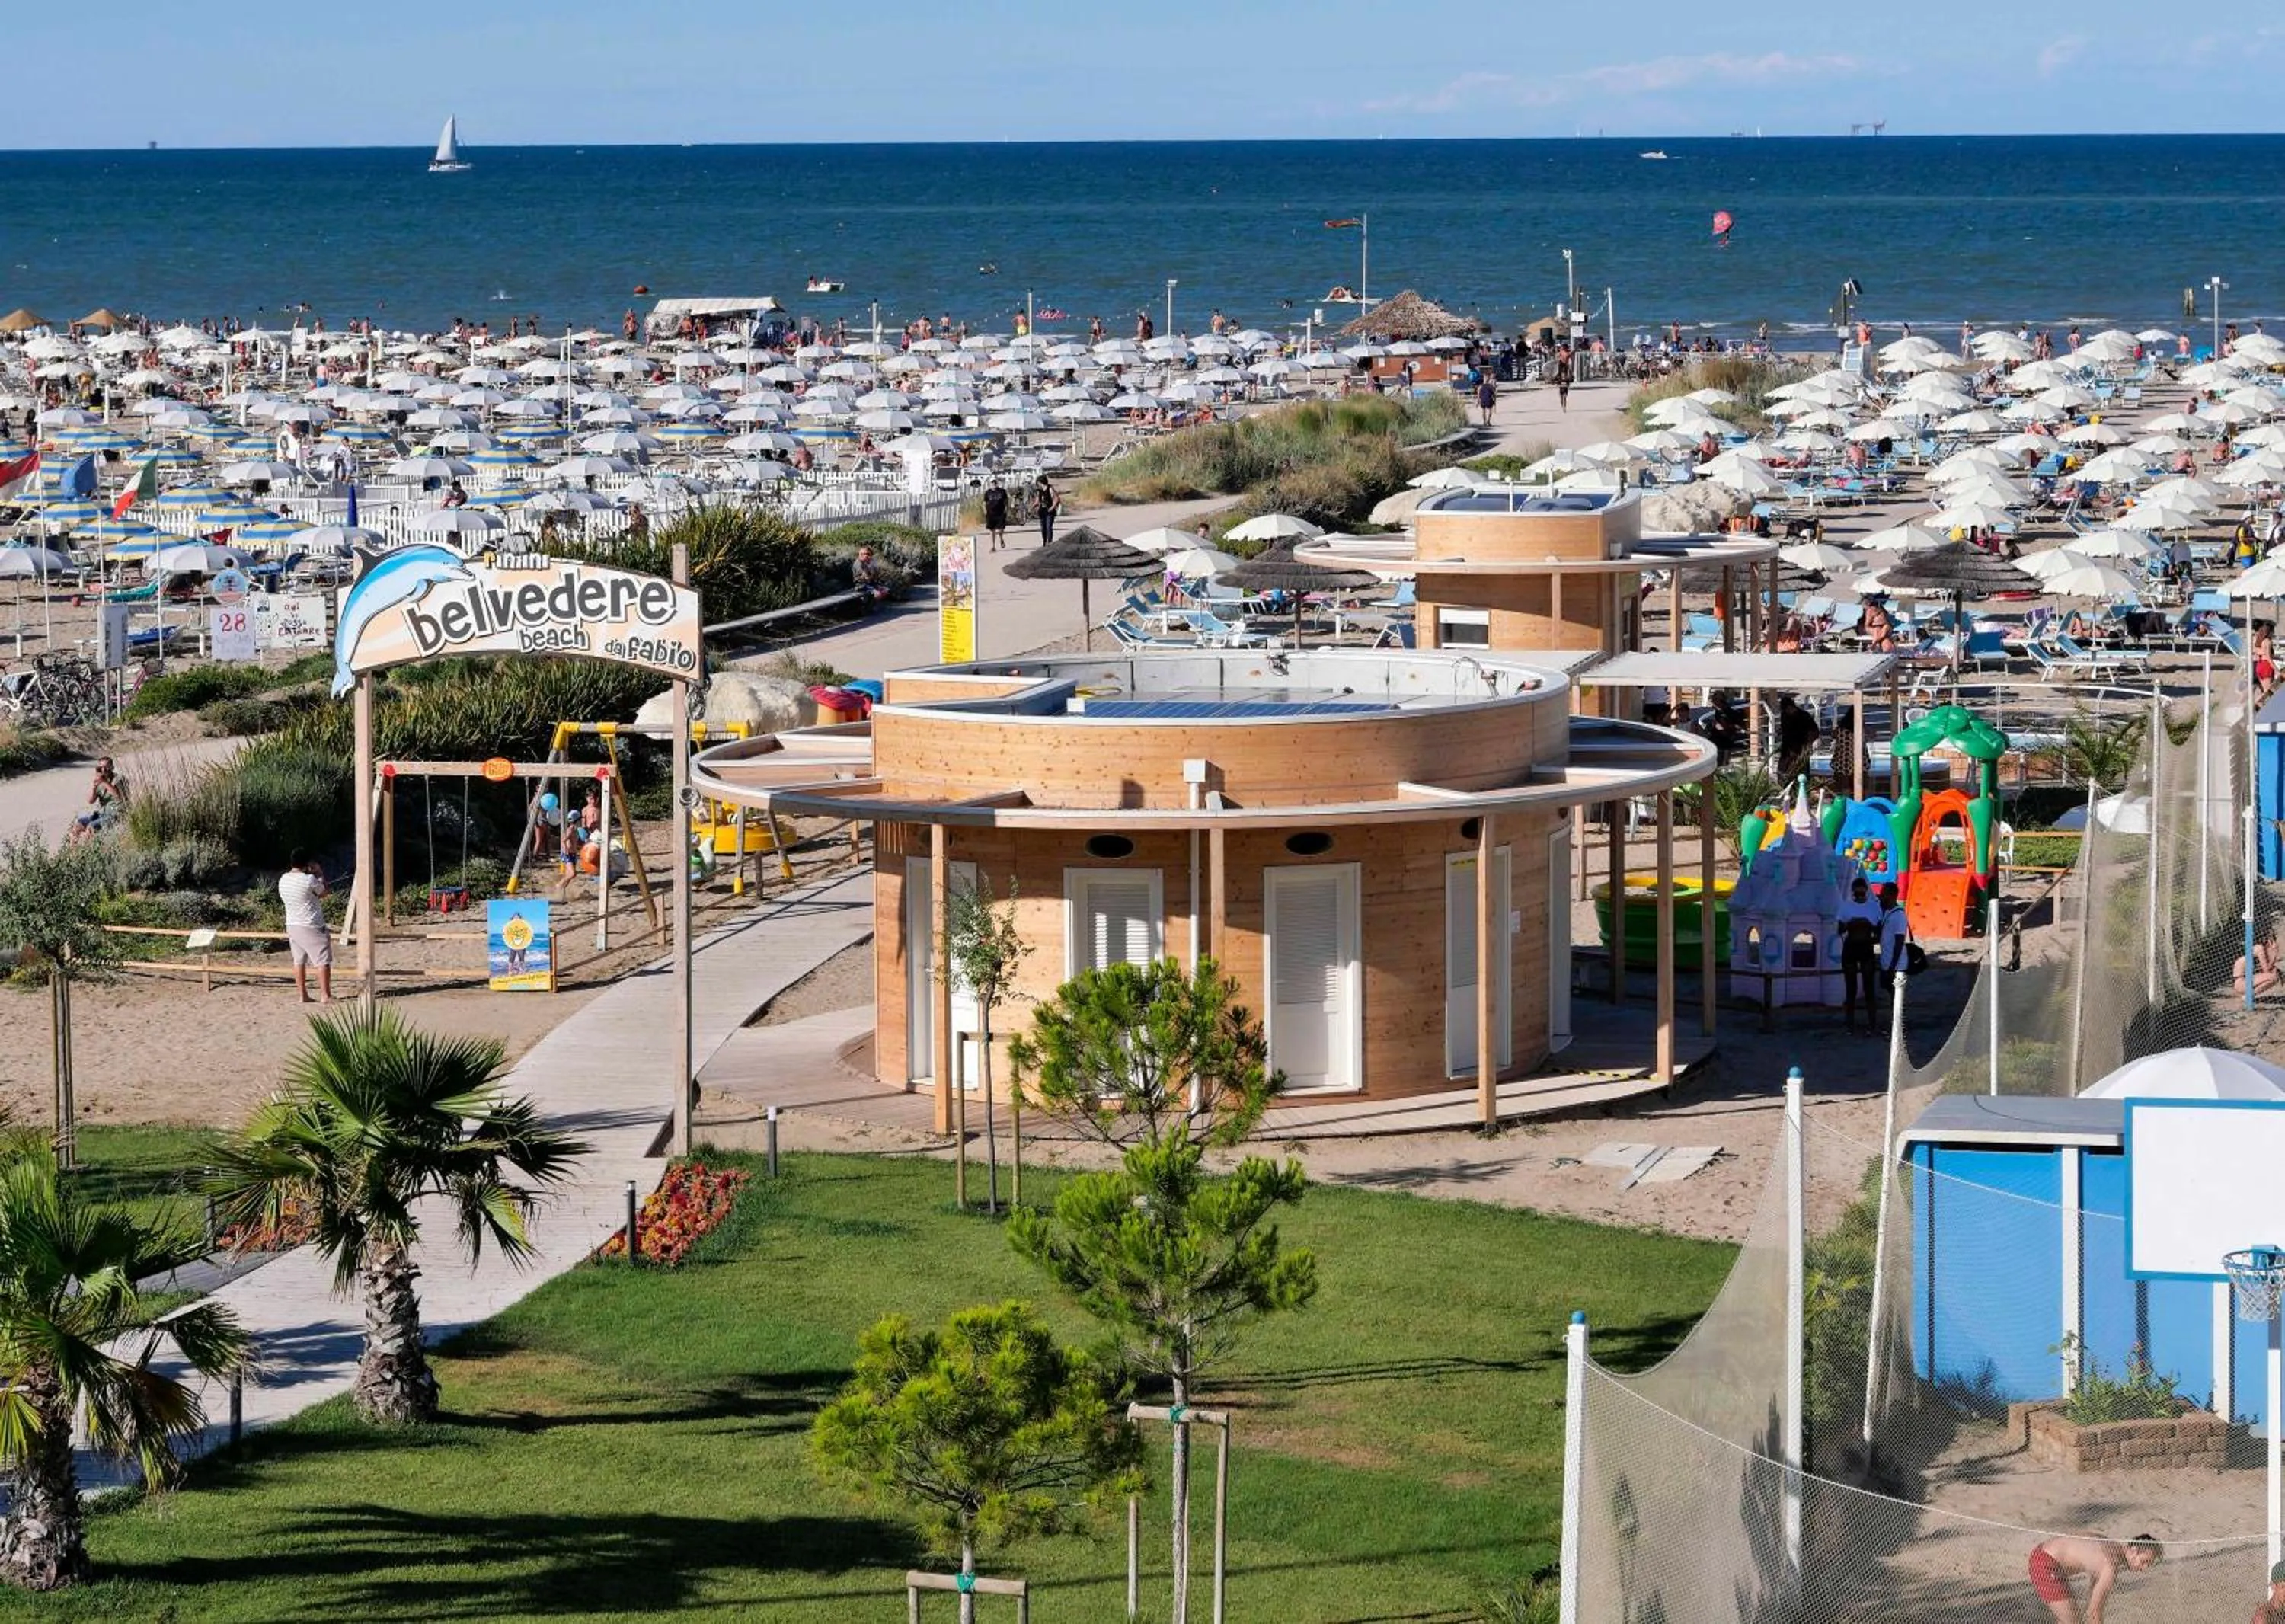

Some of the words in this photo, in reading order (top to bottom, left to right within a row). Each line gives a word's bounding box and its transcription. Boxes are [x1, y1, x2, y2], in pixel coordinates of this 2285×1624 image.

[219, 613, 246, 632] 28
[406, 571, 669, 652] belvedere
[519, 624, 586, 651] beach
